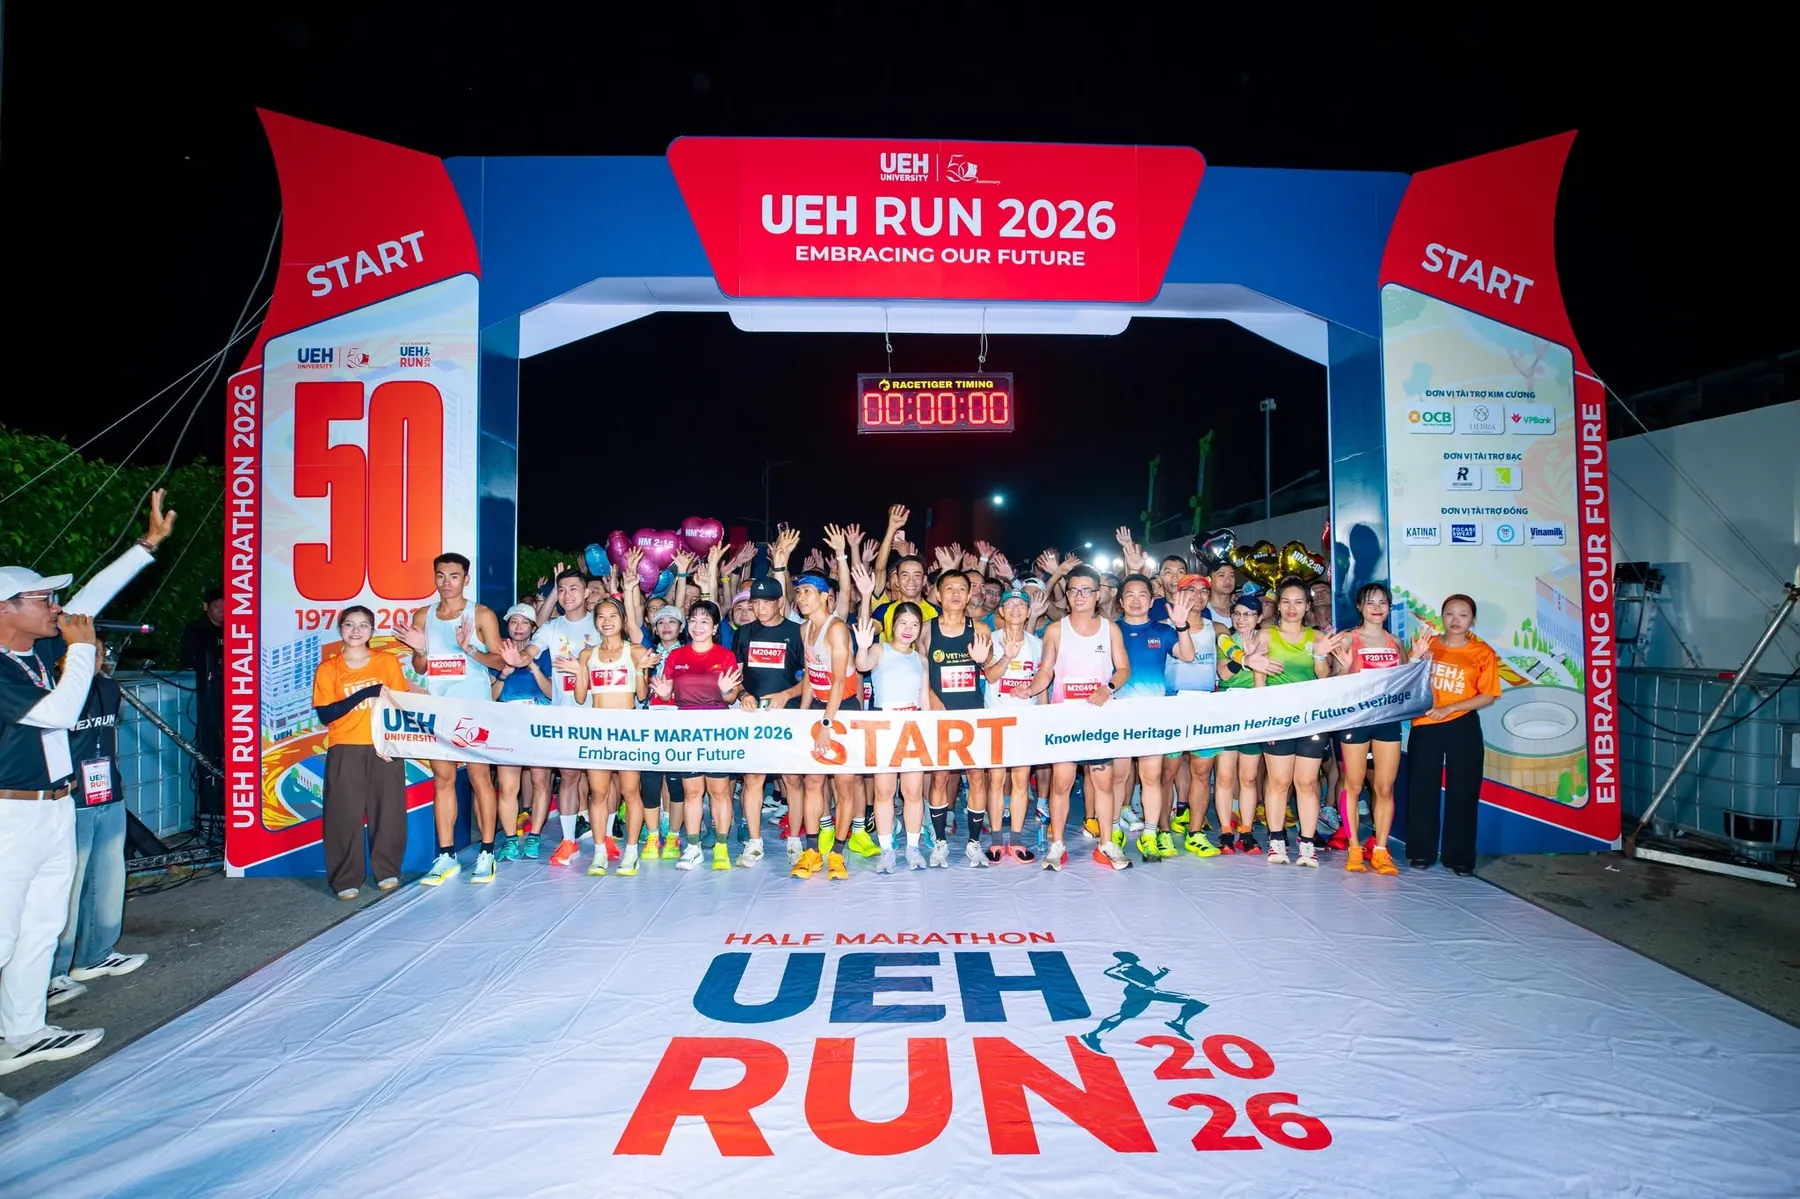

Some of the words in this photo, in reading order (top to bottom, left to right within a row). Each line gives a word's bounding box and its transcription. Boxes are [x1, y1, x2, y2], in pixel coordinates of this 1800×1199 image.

[880, 152, 929, 174] UEH
[880, 174, 928, 182] UNIVERSITY
[762, 194, 857, 235] UEH
[875, 196, 981, 236] RUN
[998, 198, 1116, 240] 2026
[306, 230, 425, 297] START
[796, 245, 935, 263] EMBRACING
[941, 248, 991, 264] OUR
[998, 249, 1085, 266] FUTURE
[1421, 242, 1534, 304] START
[298, 347, 333, 363] UEH
[400, 346, 424, 356] UEH
[400, 357, 423, 368] RUN
[892, 381, 953, 389] RACETIGER
[955, 380, 994, 388] TIMING
[1426, 389, 1444, 397] ĐƠN
[1445, 391, 1455, 399] VỊ
[1457, 389, 1469, 397] TÀI
[1470, 390, 1487, 399] TRỢ
[1506, 391, 1536, 399] CƯƠNG
[233, 385, 256, 448] 2026
[864, 392, 1008, 425] 00:00:00
[1422, 412, 1451, 422] OCB
[1444, 452, 1462, 460] ĐƠN
[1463, 453, 1473, 461] VỊ
[1474, 452, 1486, 460] TÀI
[1488, 452, 1505, 461] TRỢ
[1506, 453, 1522, 462] BẠC
[1582, 403, 1605, 524] FUTURE
[293, 380, 444, 601] 50
[1441, 507, 1460, 515] ĐƠN
[1461, 508, 1471, 517] VỊ
[1486, 507, 1502, 516] TRỢ
[232, 456, 255, 615] MARATHON
[638, 537, 652, 546] HM
[1406, 527, 1437, 537] KATINAT
[1530, 527, 1563, 536] Vinamilk
[1292, 550, 1307, 564] HM
[1307, 560, 1325, 575] 2:00
[1587, 534, 1609, 603] OUR
[295, 609, 344, 630] 197
[231, 624, 254, 694] HALF
[752, 648, 781, 656] M20407
[1044, 728, 1120, 745] Knowledge
[1123, 727, 1182, 742] Heritage
[1193, 722, 1240, 736] Human
[1244, 714, 1300, 730] Heritage
[1311, 705, 1355, 721] Future
[1358, 689, 1412, 713] Heritage
[1590, 612, 1616, 803] EMBRACING
[383, 708, 436, 735] UEH
[530, 724, 563, 739] UEH
[568, 726, 602, 741] RUN
[607, 727, 649, 742] HALF
[654, 726, 749, 742] MARATHON
[753, 726, 793, 740] 2026
[232, 704, 255, 763] RUN
[274, 729, 292, 741] UEH
[384, 732, 437, 743] UNIVERSITY
[810, 717, 1018, 767] START
[578, 746, 660, 765] Embracing
[665, 748, 692, 761] Our
[697, 747, 746, 761] Future
[232, 772, 255, 828] UEH
[723, 931, 823, 946] HALF
[834, 931, 1056, 946] MARATHON
[692, 950, 1094, 1025] UEH
[1134, 1033, 1276, 1080] 20
[612, 1036, 1159, 1157] RUN
[1167, 1092, 1334, 1153] 26
